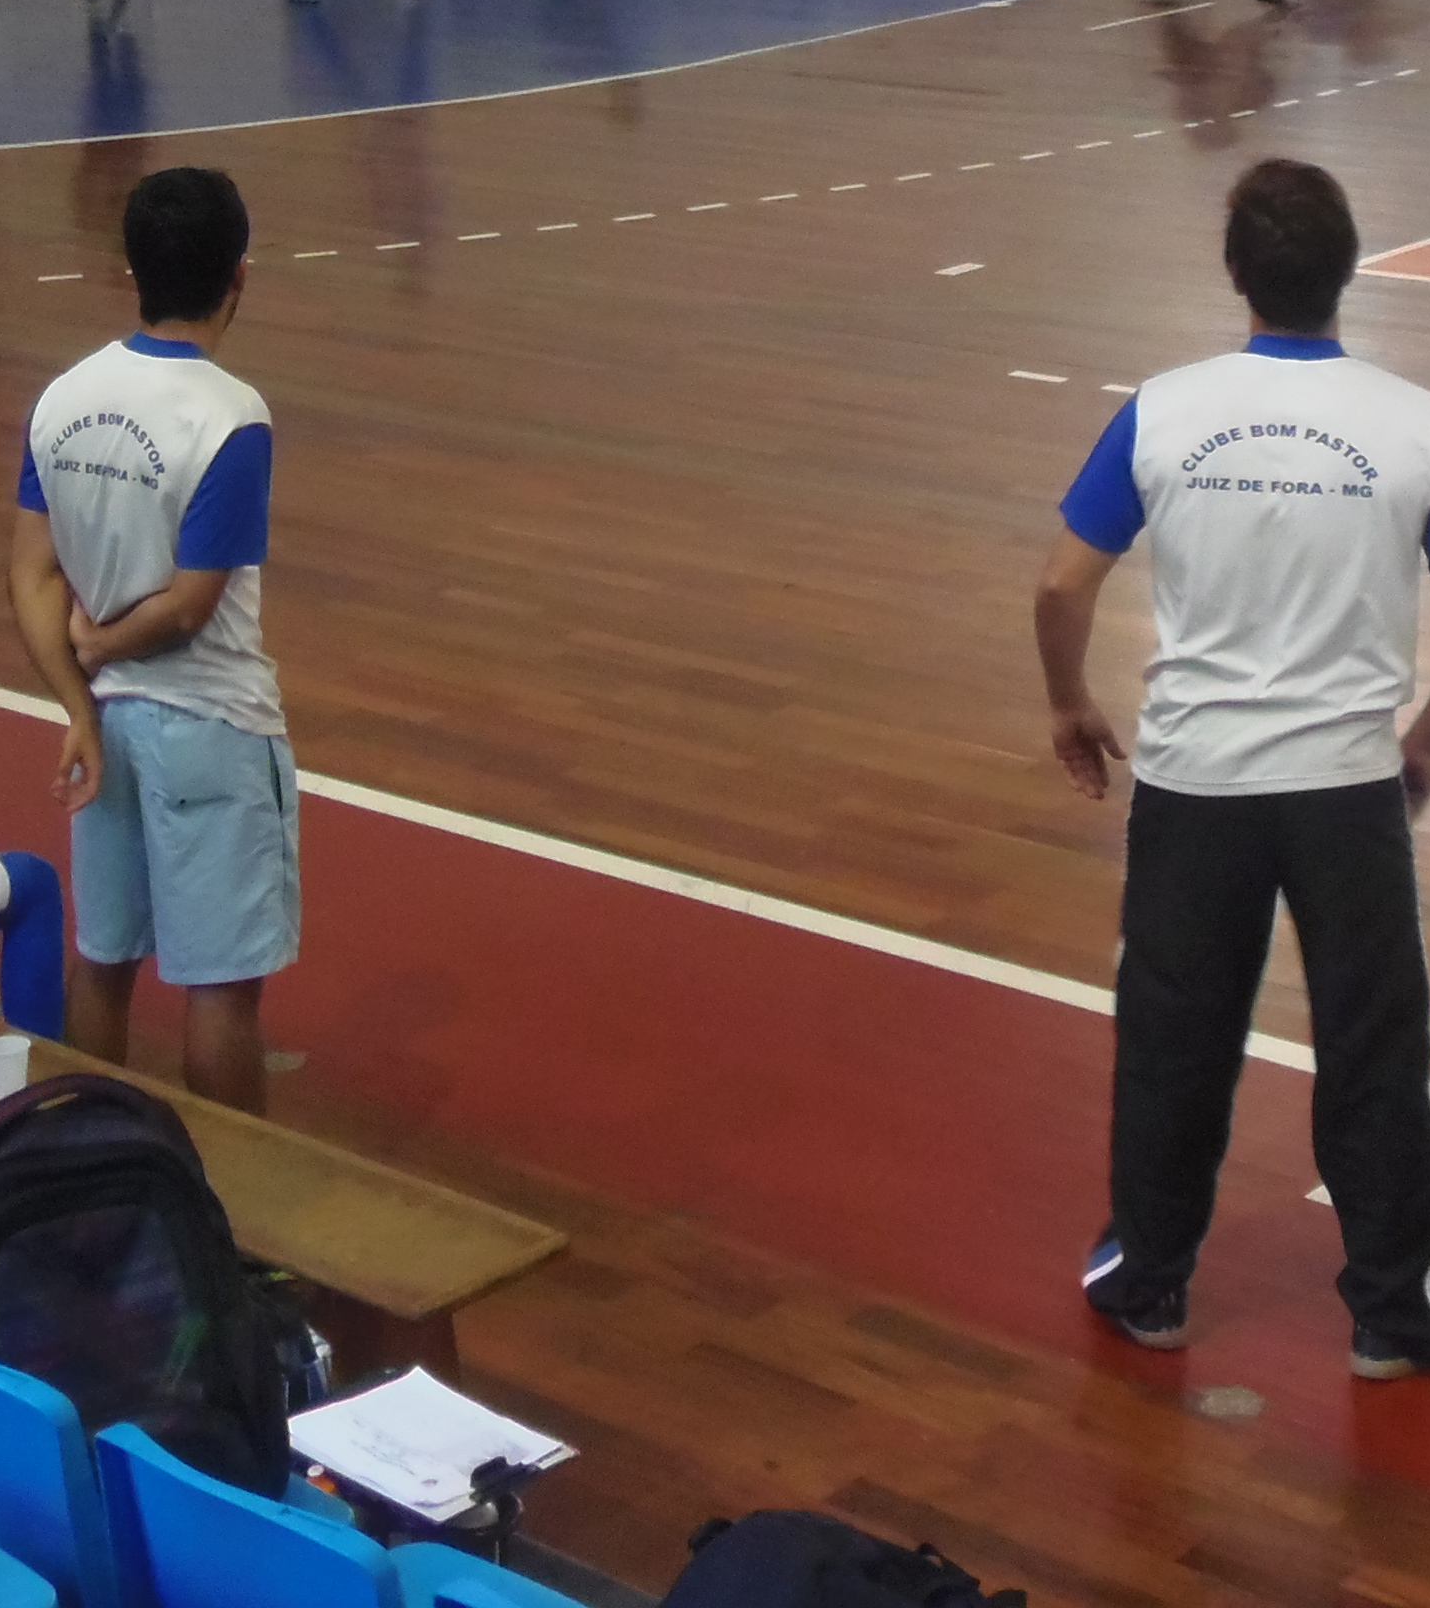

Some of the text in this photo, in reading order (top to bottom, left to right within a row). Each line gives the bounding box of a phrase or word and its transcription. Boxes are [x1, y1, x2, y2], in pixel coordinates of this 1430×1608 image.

[51, 413, 165, 476] CLUBE BOM PASTOR
[1182, 424, 1379, 482] CLUBE BOM PASTOR
[53, 459, 81, 472] JUIZ
[1186, 477, 1231, 491] JUIZ
[1237, 479, 1264, 492] DE
[1271, 481, 1323, 495] FORA
[1342, 484, 1373, 498] MG
